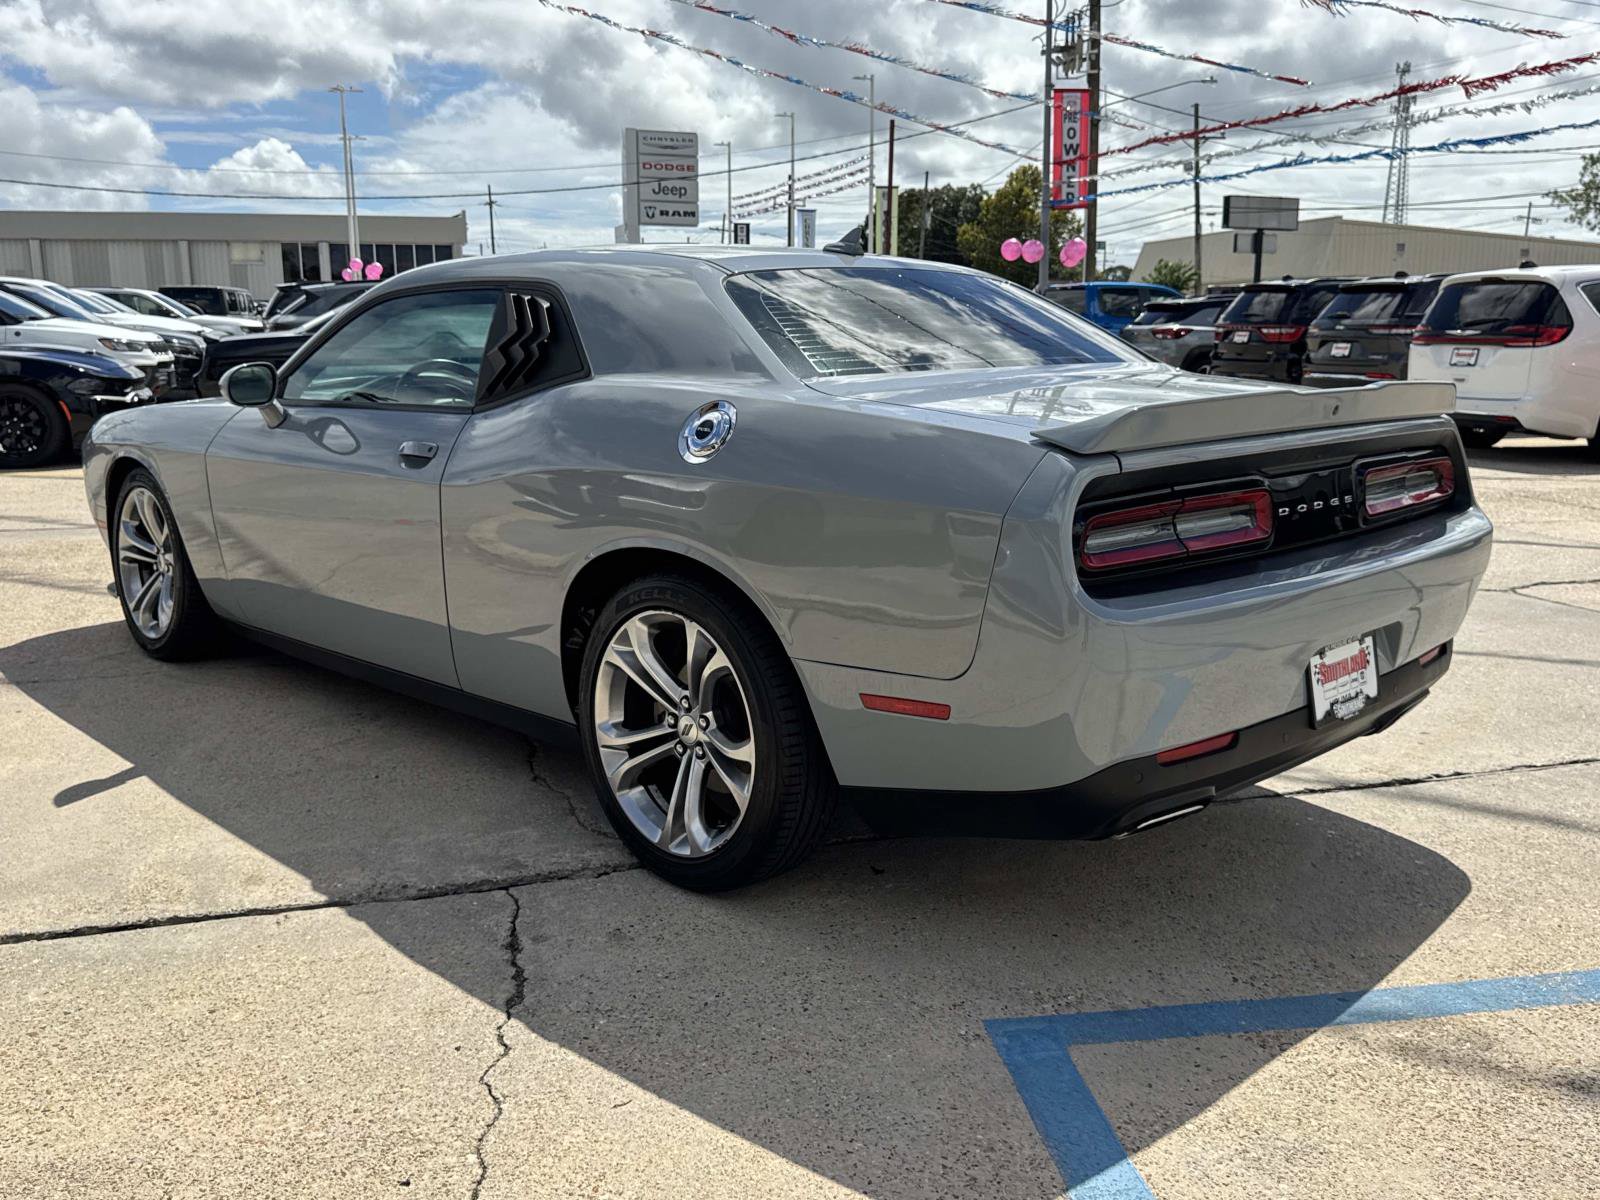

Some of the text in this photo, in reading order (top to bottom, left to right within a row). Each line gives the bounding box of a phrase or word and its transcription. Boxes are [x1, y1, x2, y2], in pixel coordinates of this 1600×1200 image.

[642, 162, 695, 172] DODGE
[652, 182, 687, 198] Jeep
[659, 209, 696, 218] RAM
[1278, 495, 1353, 516] DODGE
